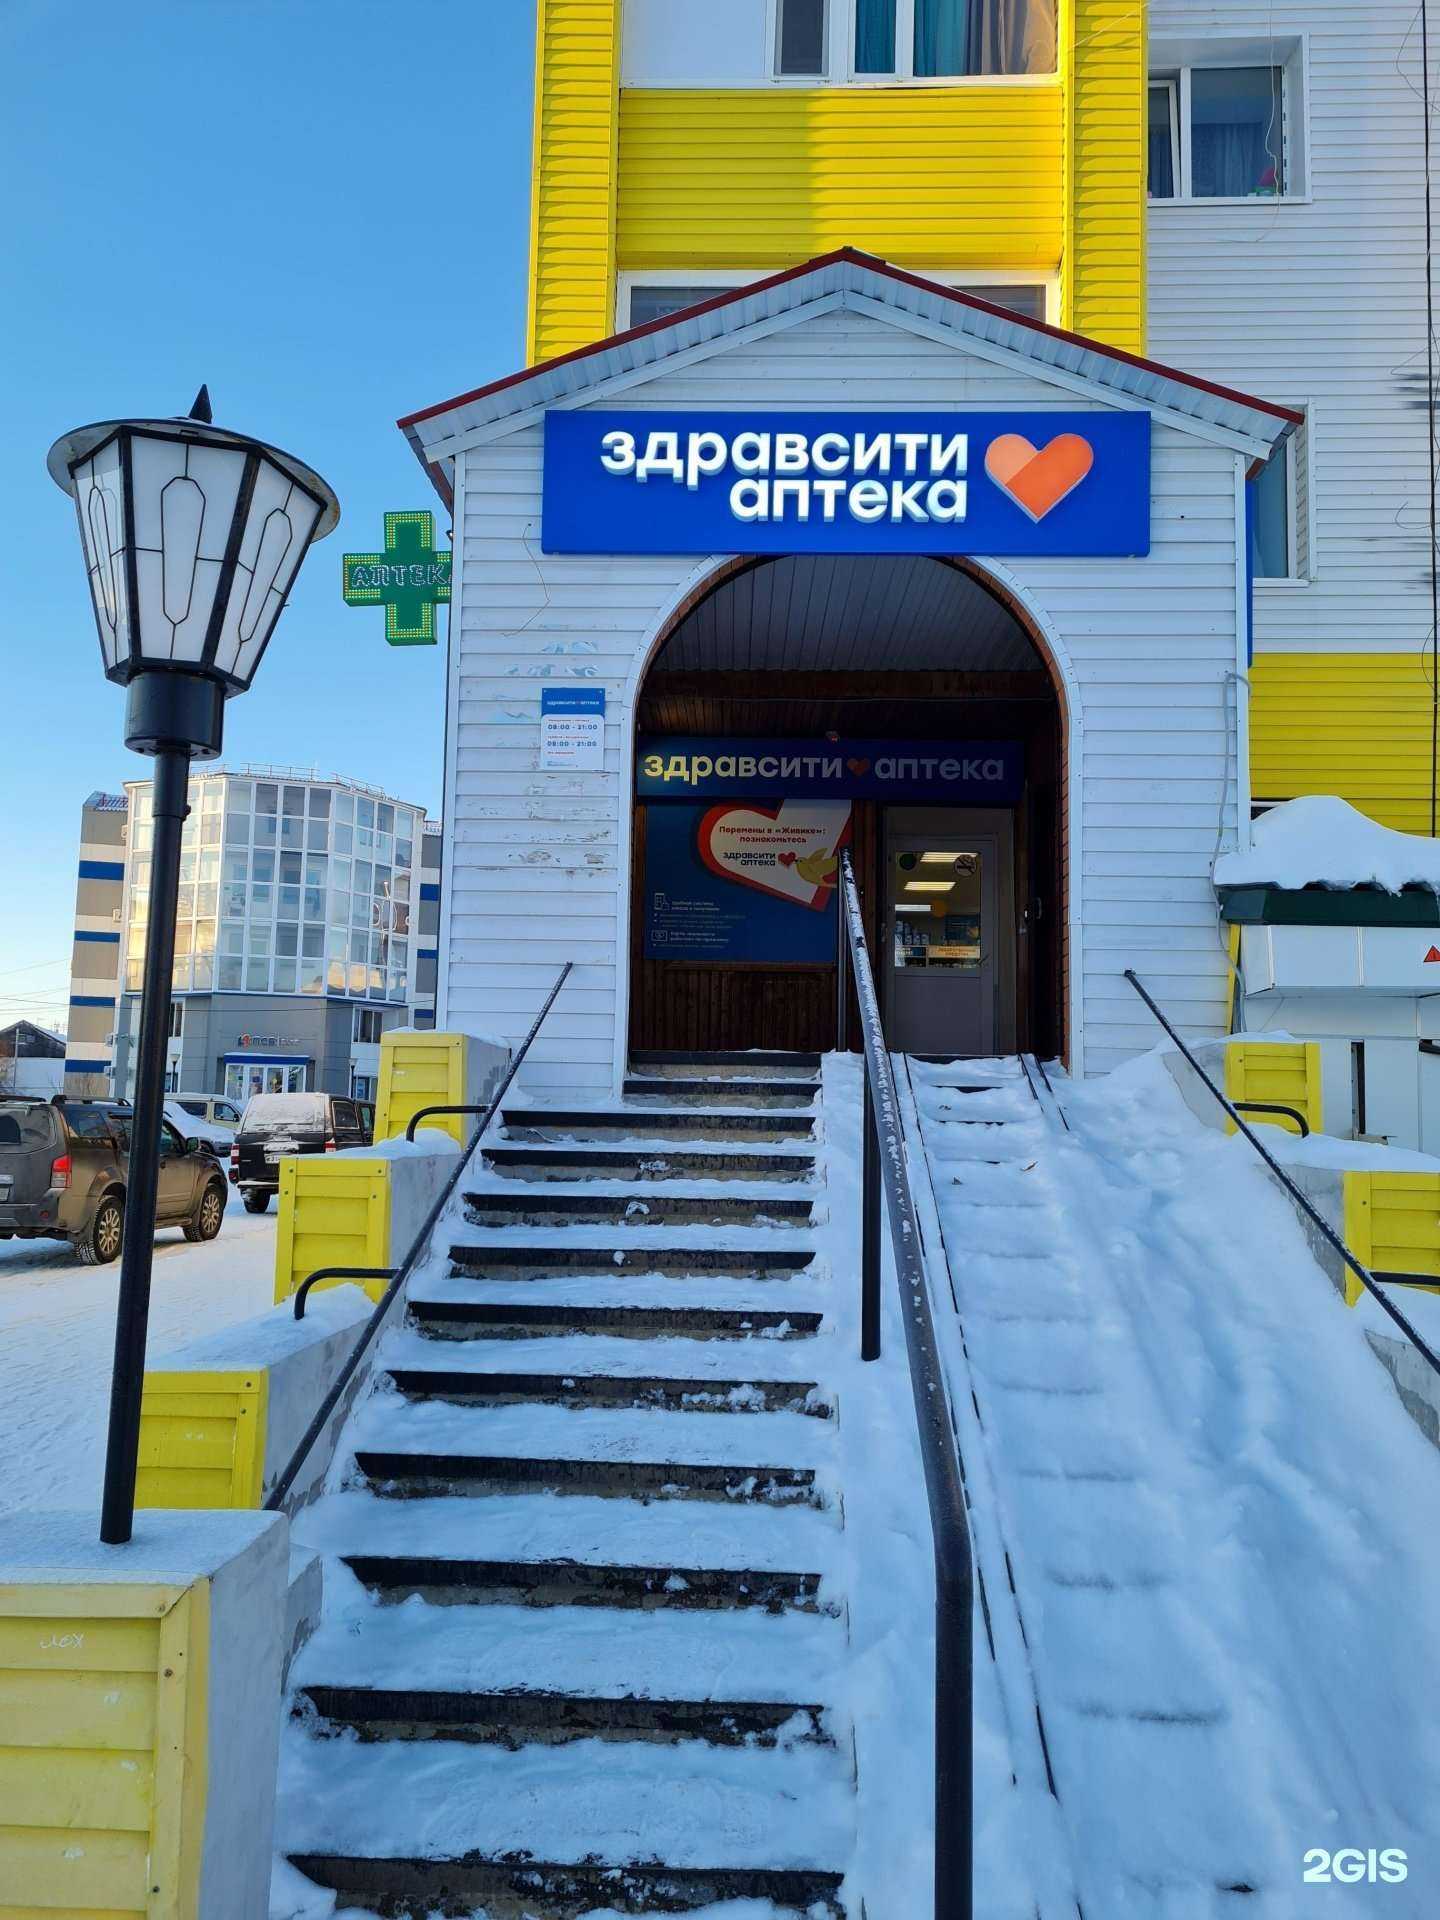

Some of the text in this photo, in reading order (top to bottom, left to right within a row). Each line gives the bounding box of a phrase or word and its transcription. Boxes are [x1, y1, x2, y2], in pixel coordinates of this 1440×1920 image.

[600, 430, 968, 490] здравсити
[729, 478, 968, 523] аптека
[643, 754, 1004, 785] здравсити аптека
[719, 826, 765, 835] Перемены
[723, 852, 776, 861] здравсити
